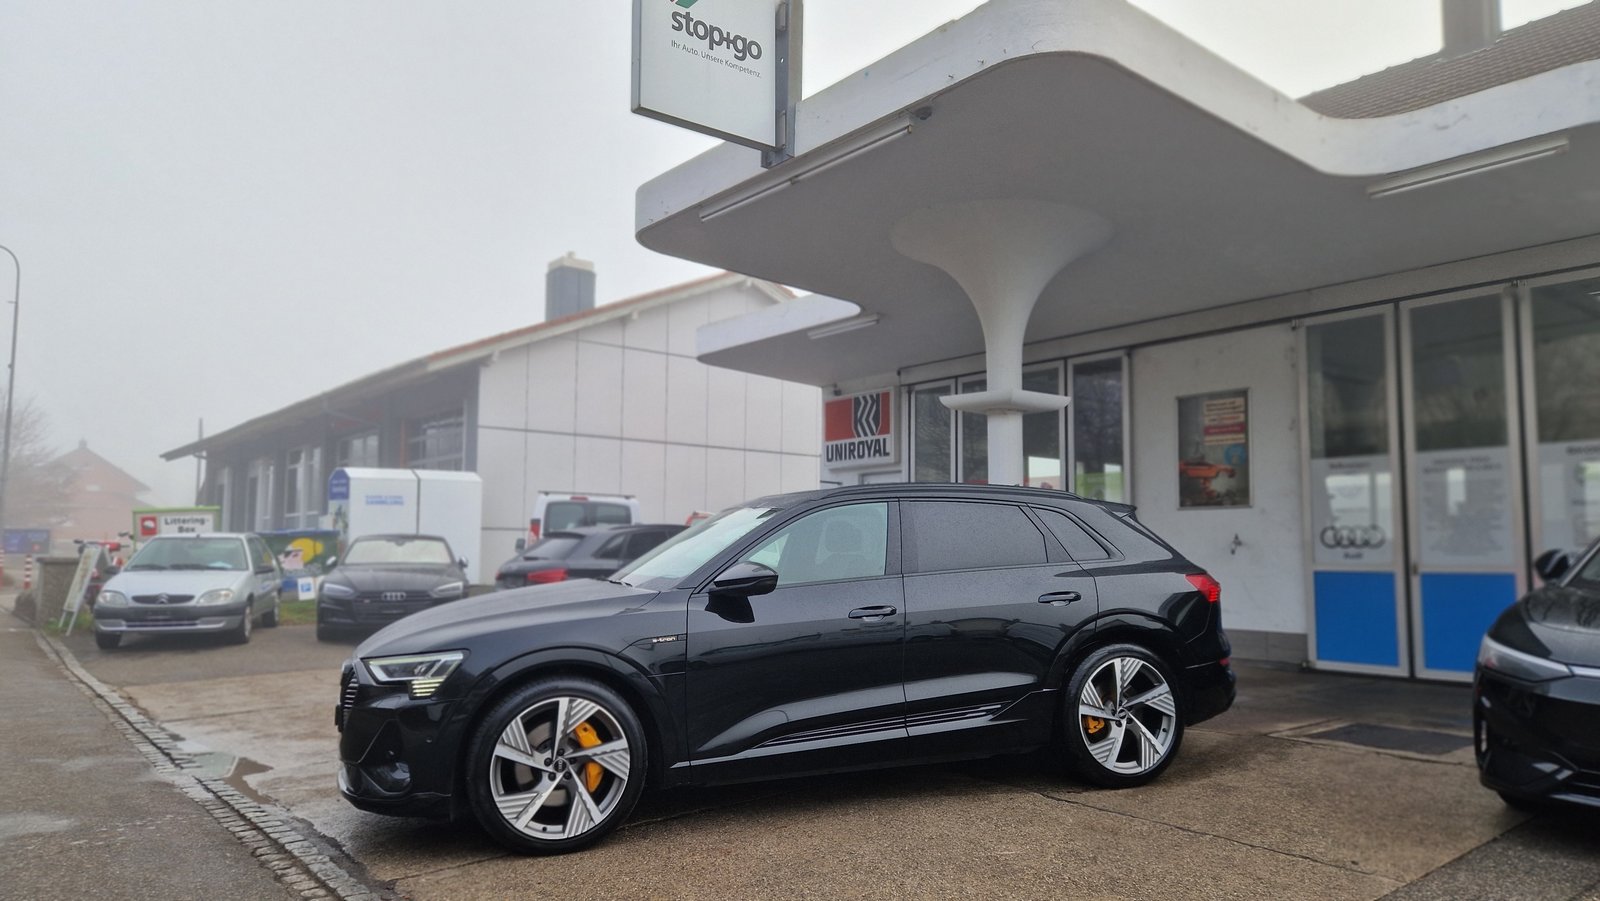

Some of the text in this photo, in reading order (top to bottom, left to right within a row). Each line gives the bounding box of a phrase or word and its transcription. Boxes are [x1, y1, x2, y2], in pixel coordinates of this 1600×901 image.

[671, 10, 762, 62] stop+go
[671, 39, 681, 49] Ihr
[701, 50, 724, 65] Unsere
[826, 437, 890, 462] UNIROYAL
